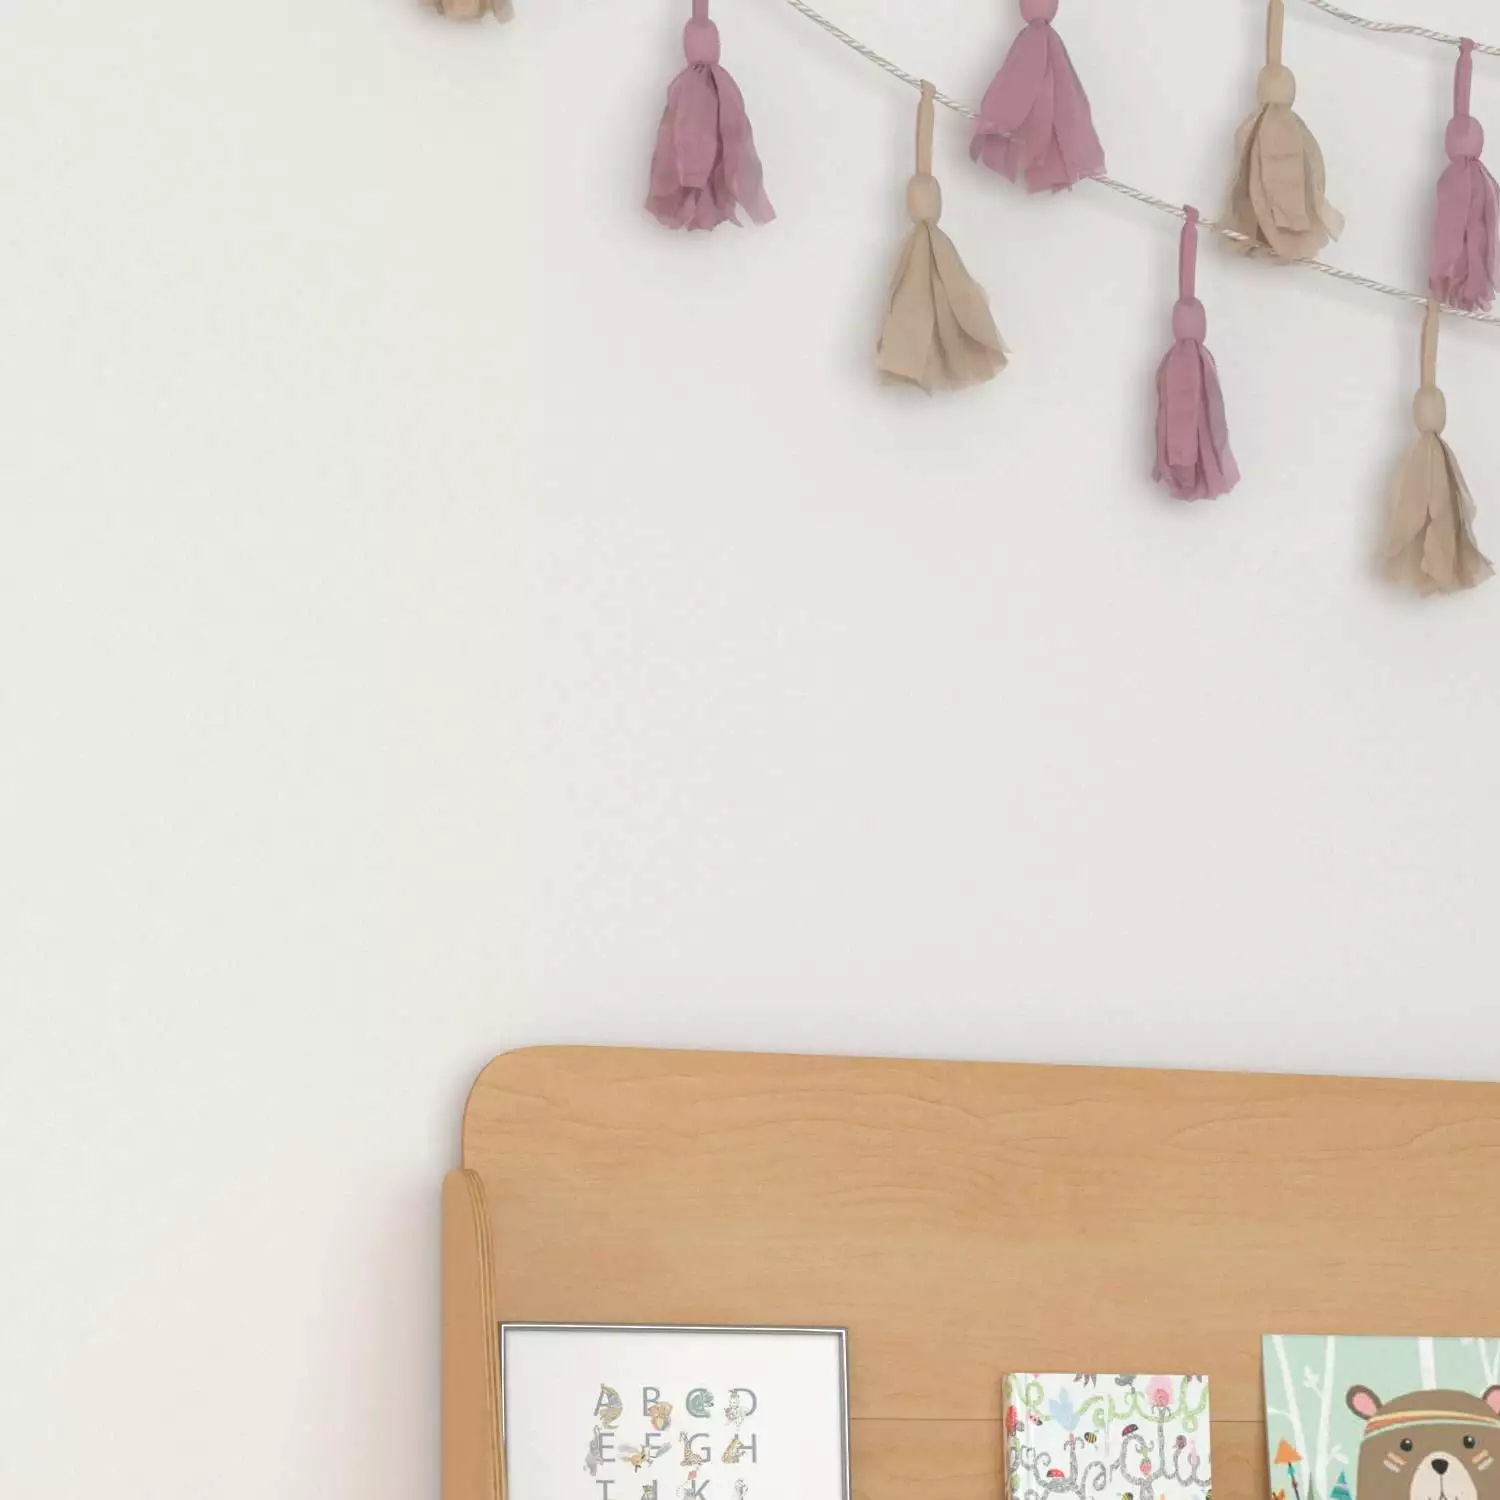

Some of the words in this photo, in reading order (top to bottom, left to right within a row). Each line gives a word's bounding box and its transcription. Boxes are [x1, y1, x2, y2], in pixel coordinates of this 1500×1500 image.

[643, 1386, 662, 1416] B
[732, 1388, 757, 1416] D
[599, 1432, 615, 1462] E
[688, 1433, 711, 1462] G
